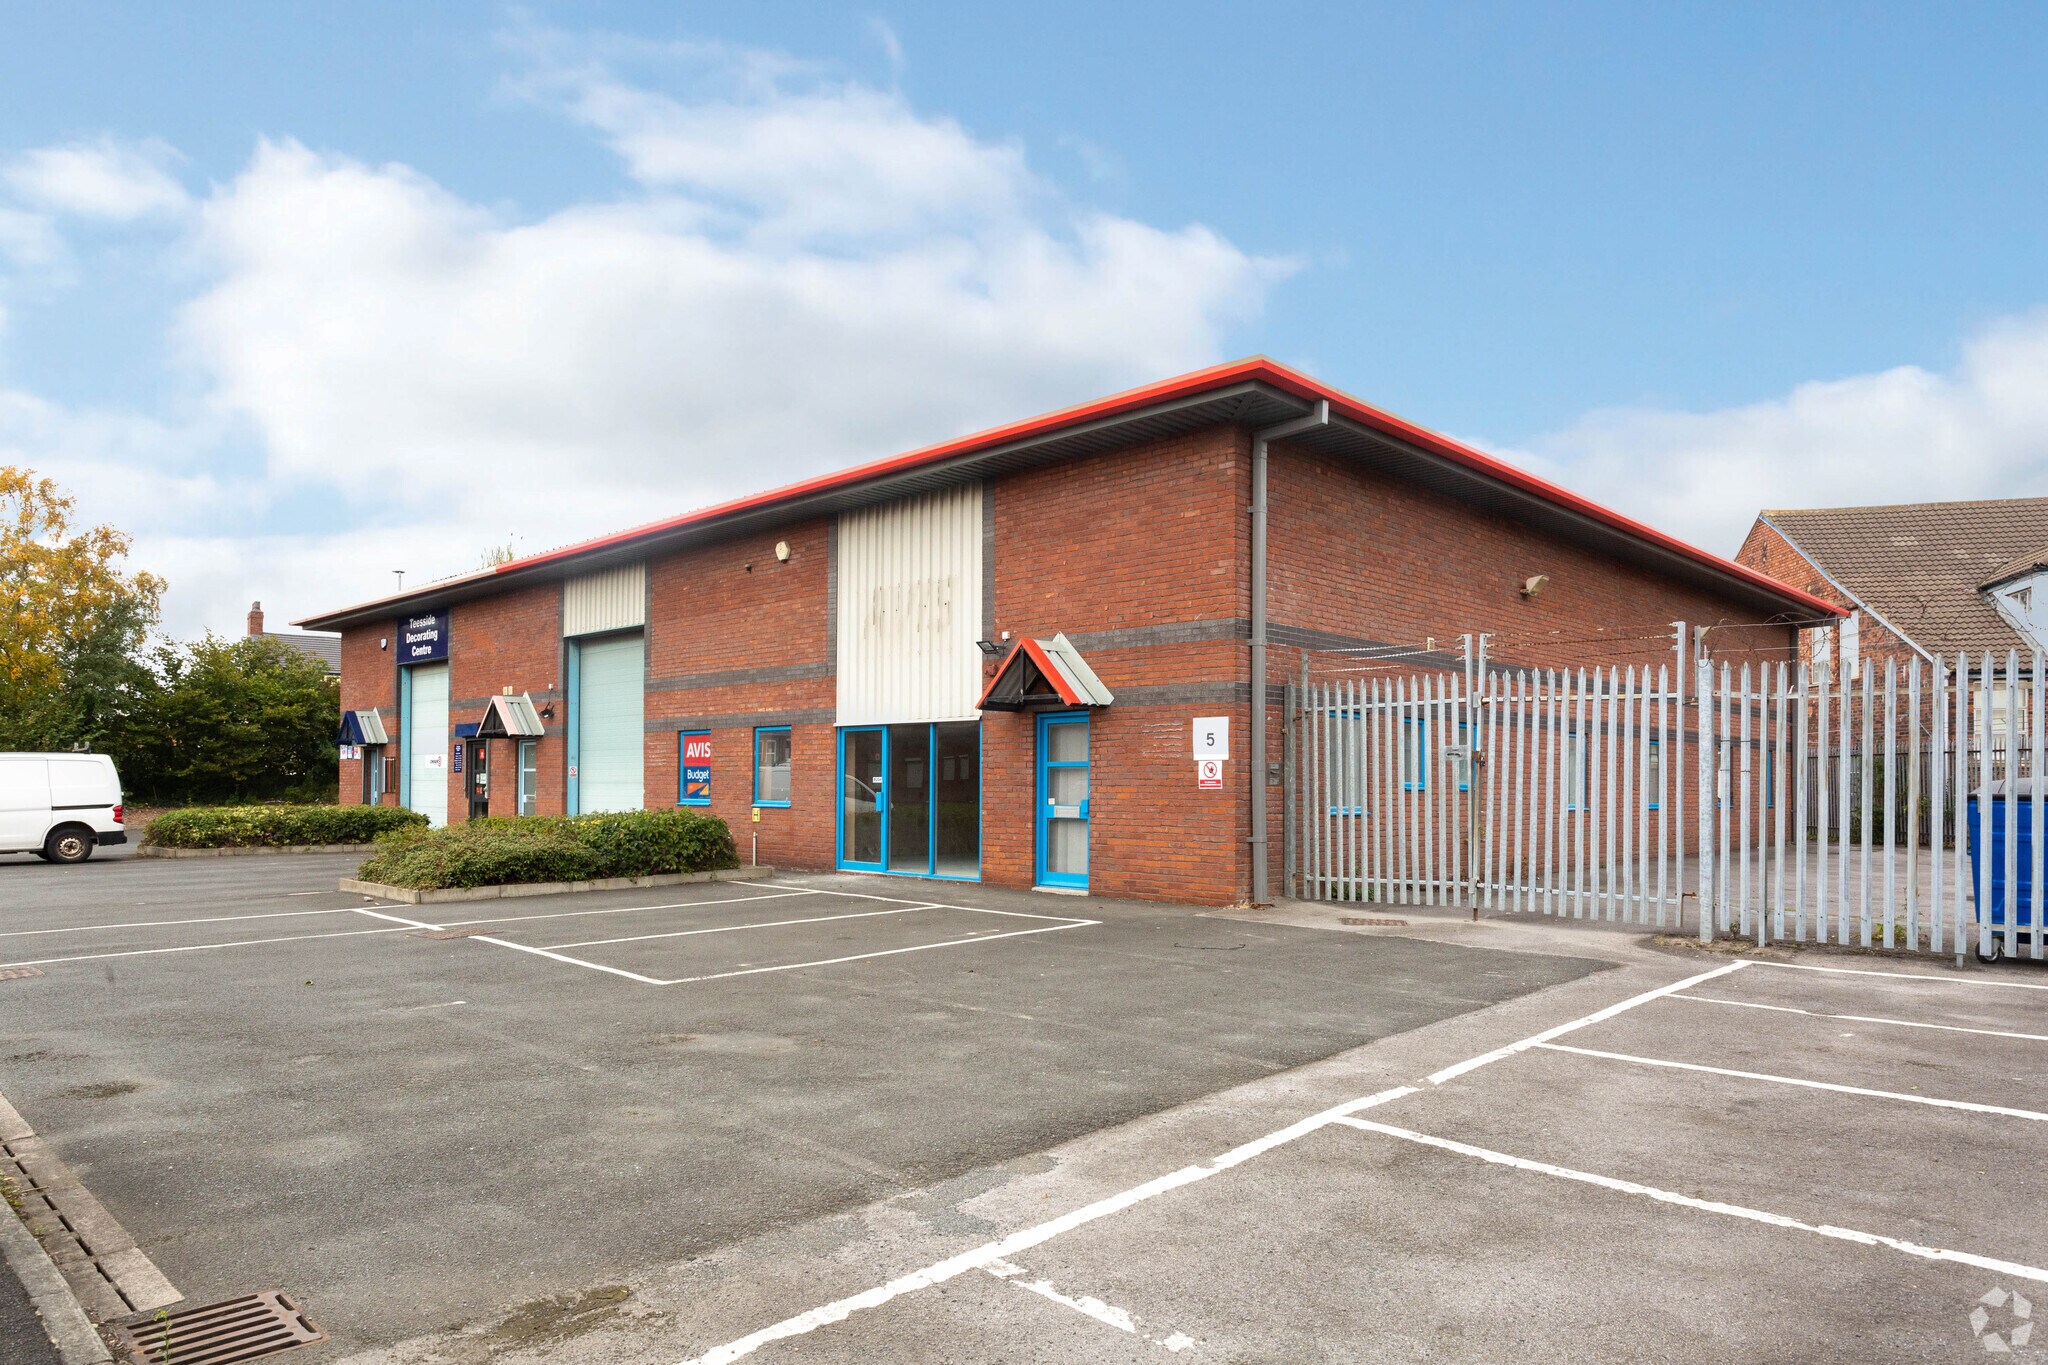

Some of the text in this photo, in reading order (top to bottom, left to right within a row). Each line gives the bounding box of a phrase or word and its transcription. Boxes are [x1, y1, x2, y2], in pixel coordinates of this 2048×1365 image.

[409, 614, 436, 629] Teesside
[406, 629, 438, 644] Decorating
[411, 645, 432, 657] Centre
[1206, 732, 1215, 747] 5
[686, 742, 711, 758] AVIS
[687, 769, 710, 782] Budget
